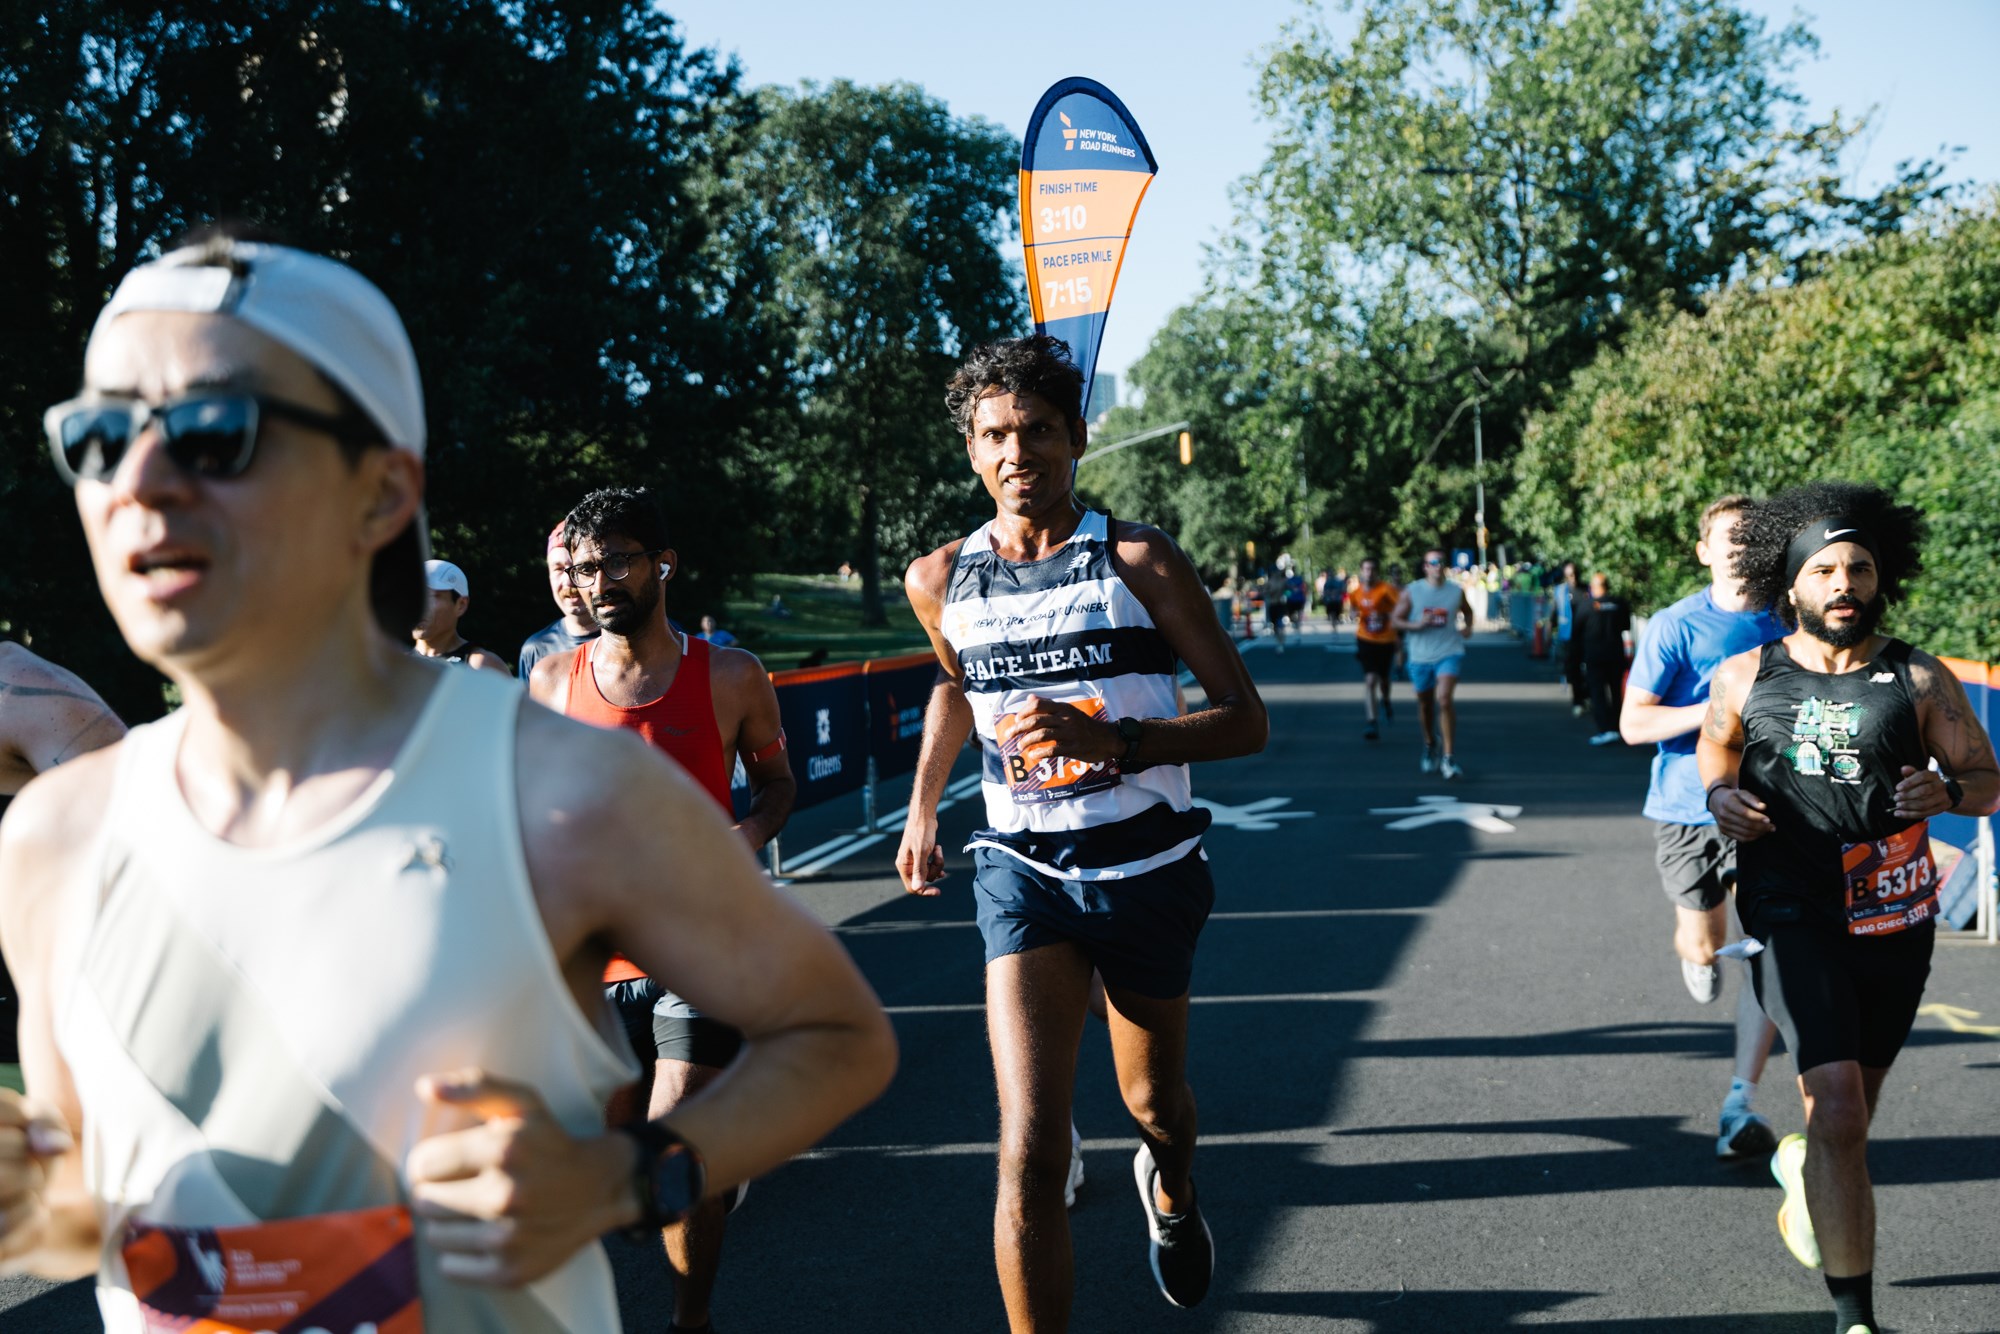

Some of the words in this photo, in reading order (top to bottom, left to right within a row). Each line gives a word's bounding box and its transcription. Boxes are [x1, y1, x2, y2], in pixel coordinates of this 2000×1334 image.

[1079, 128, 1097, 140] NEW
[1097, 131, 1117, 143] YORK
[1080, 141, 1101, 152] ROAD
[1101, 143, 1136, 158] RUNNERS
[1039, 183, 1072, 195] FINISH
[1074, 181, 1098, 193] TIME
[1040, 204, 1087, 233] 3:10
[1043, 256, 1069, 269] PACE
[1071, 253, 1090, 265] PER
[1091, 250, 1112, 263] MILE
[1045, 276, 1092, 308] 7:15
[1027, 609, 1055, 622] ROAD
[1057, 601, 1109, 616] RUNNERS
[964, 655, 1024, 680] PACE
[1029, 643, 1113, 674] TEAM
[808, 754, 842, 781] Citizens
[1009, 755, 1029, 782] B
[1852, 877, 1868, 901] B
[1876, 856, 1931, 898] 5373
[1854, 924, 1875, 935] BAG
[1876, 916, 1908, 930] CHECK
[1908, 903, 1929, 924] 5373
